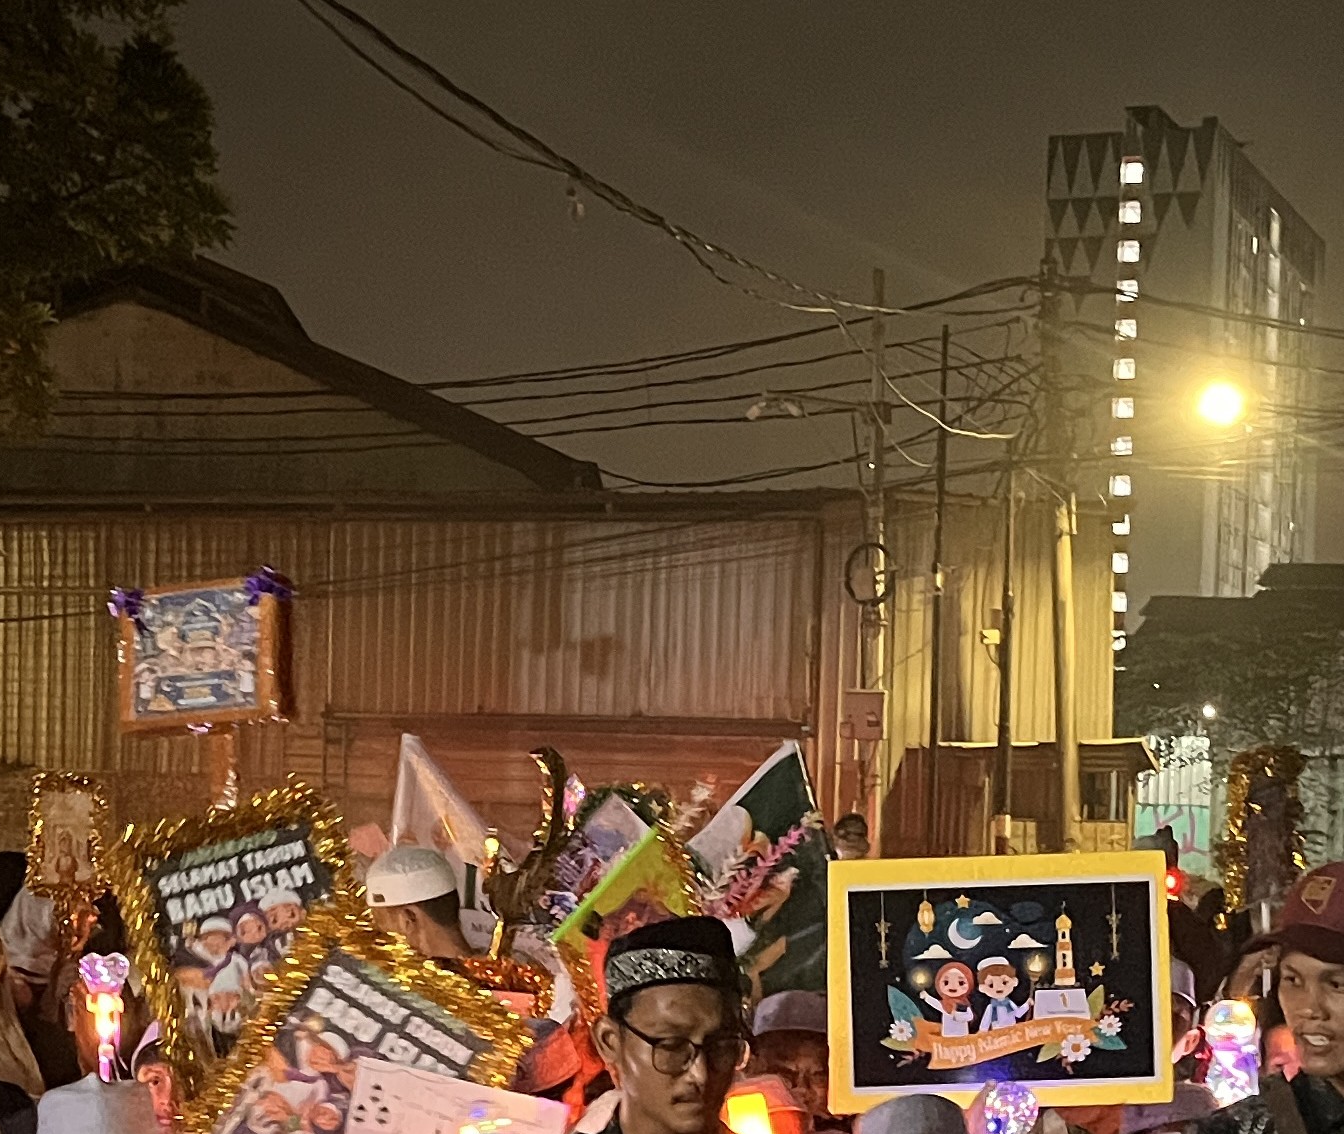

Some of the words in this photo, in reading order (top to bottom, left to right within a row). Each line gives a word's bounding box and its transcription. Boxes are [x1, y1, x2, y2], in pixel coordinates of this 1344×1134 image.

[166, 883, 235, 925] BARU
[240, 862, 315, 902] ISLAM
[932, 1041, 977, 1063] Happy
[1025, 1023, 1052, 1042] New
